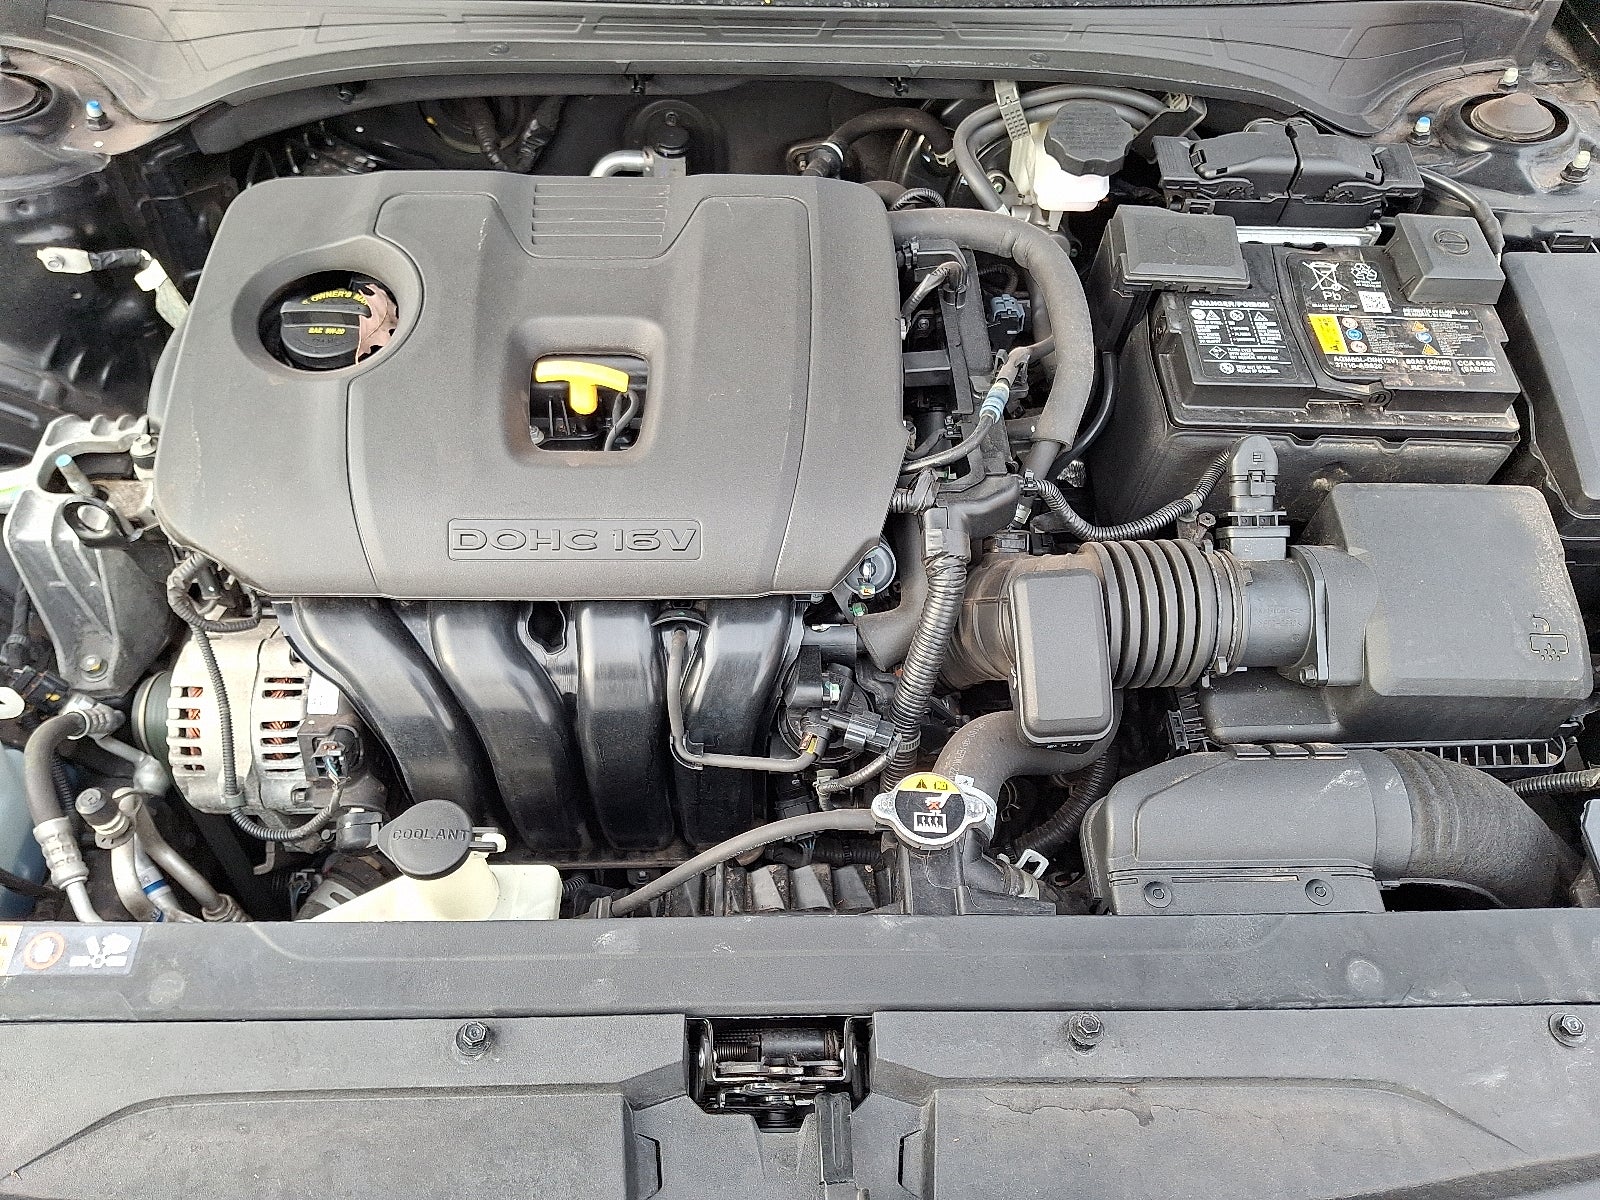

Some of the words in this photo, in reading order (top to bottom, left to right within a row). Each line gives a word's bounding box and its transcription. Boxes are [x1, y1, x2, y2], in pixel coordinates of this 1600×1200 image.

[311, 289, 353, 302] OWNER'S
[1323, 291, 1341, 301] Pb
[452, 529, 599, 551] DOHC
[612, 529, 697, 552] 16V
[393, 828, 469, 841] COOLANT
